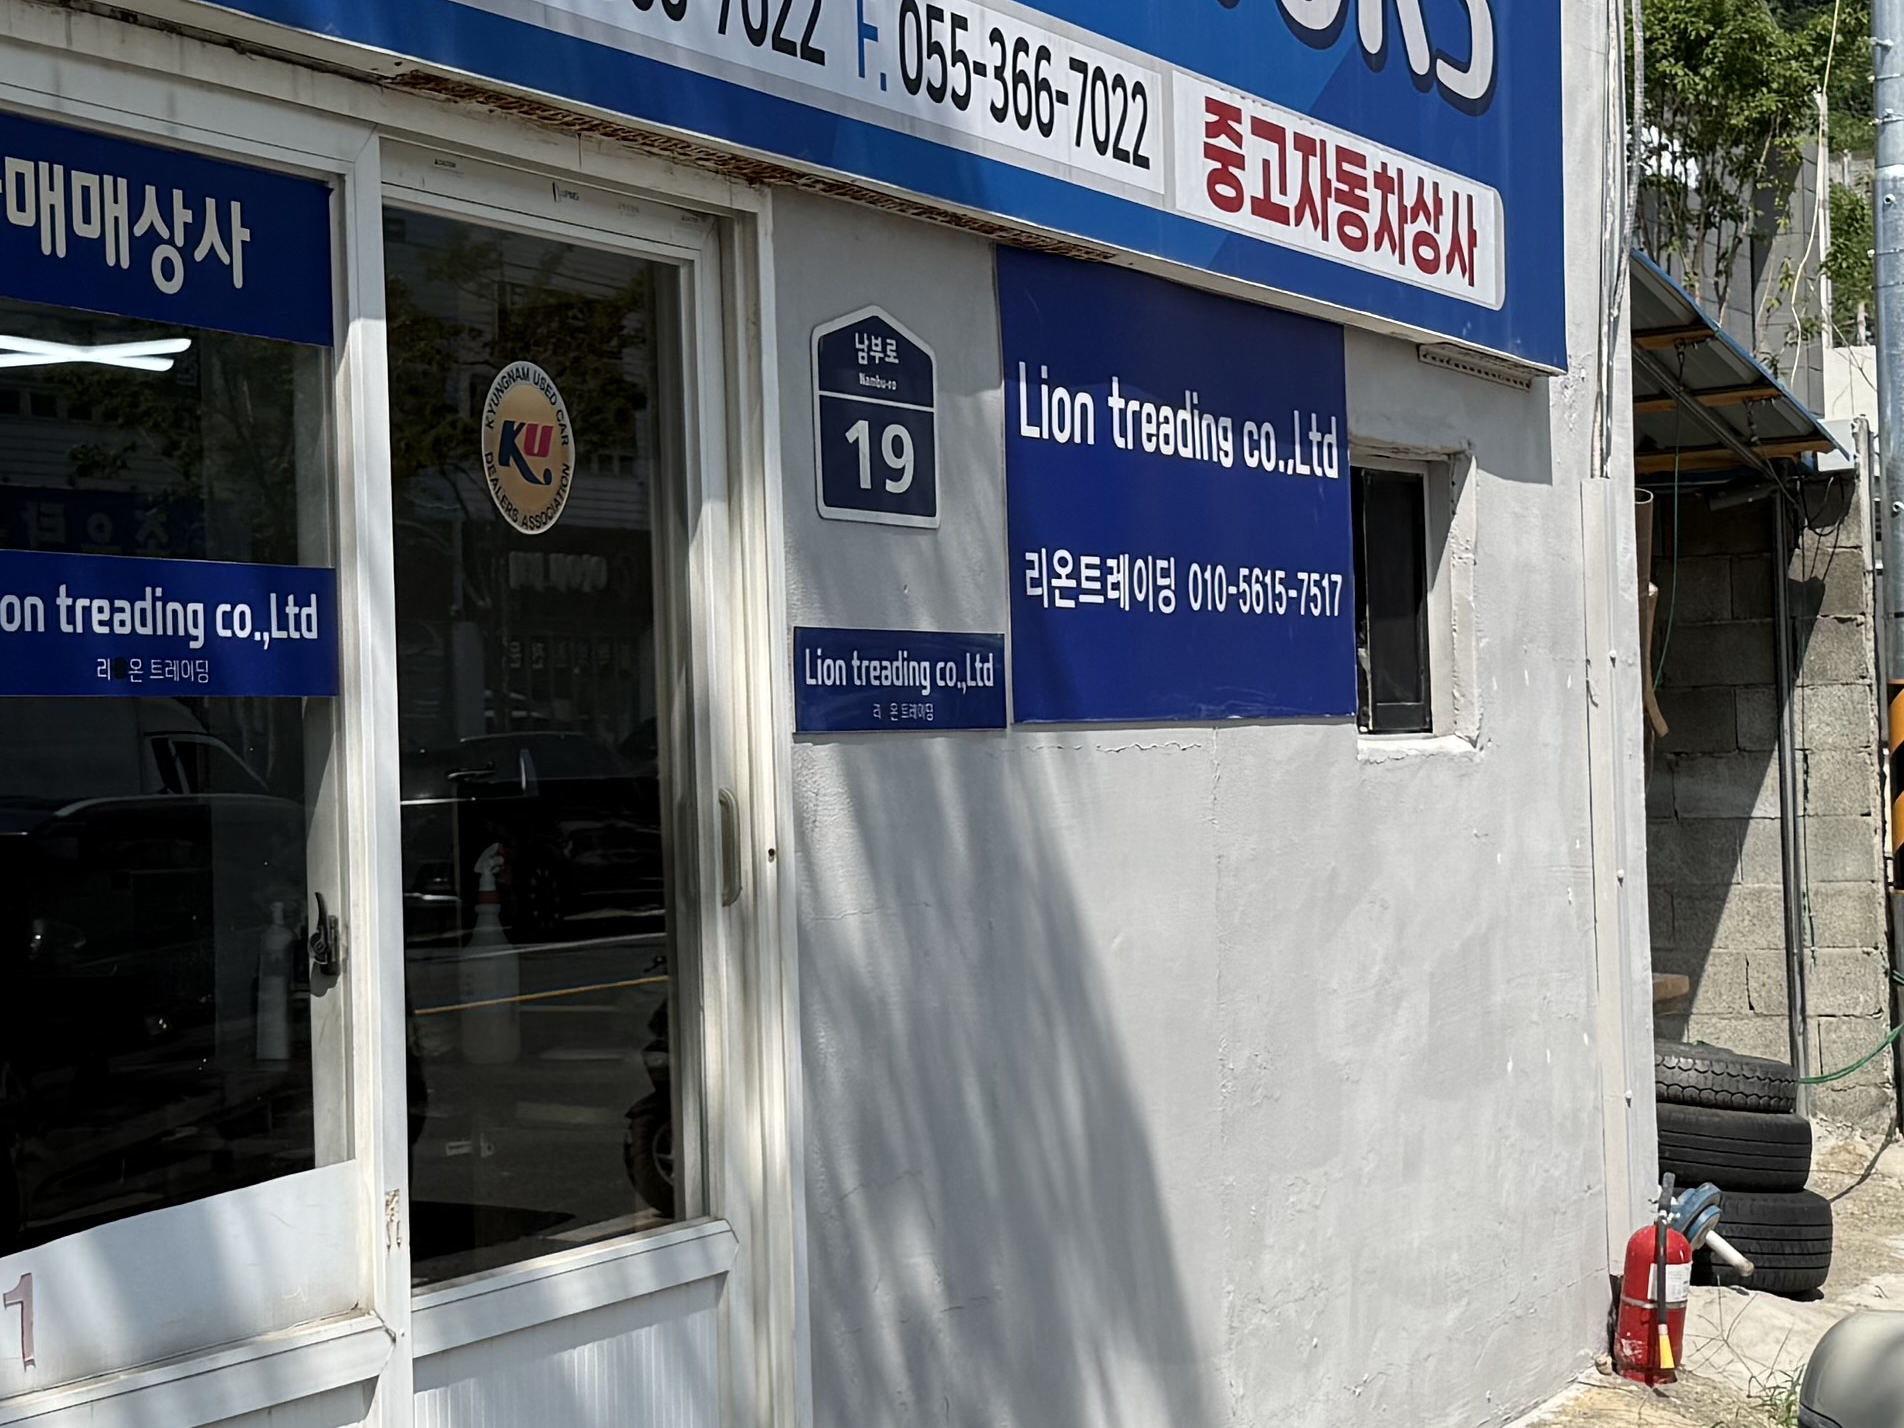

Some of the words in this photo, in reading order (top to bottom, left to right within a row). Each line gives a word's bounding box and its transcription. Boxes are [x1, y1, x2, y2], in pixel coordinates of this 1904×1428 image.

[1204, 97, 1476, 287] 중고자동차상사
[855, 332, 899, 365] 남부로
[859, 373, 897, 390] Nambu-ro
[486, 366, 530, 429] KYUNGNAM
[532, 370, 557, 406] USED
[556, 409, 569, 446] CAR
[1019, 361, 1095, 445] Lion
[1108, 376, 1234, 468] treading
[485, 452, 519, 523] DEALERS
[521, 463, 570, 531] ASSOCIATION
[845, 419, 914, 494] 19
[56, 584, 204, 649] treading
[1025, 548, 1176, 613] 리온트레이딩
[1188, 562, 1342, 617] 010-5615-7517
[805, 648, 846, 686] Lion
[852, 650, 931, 696] treading
